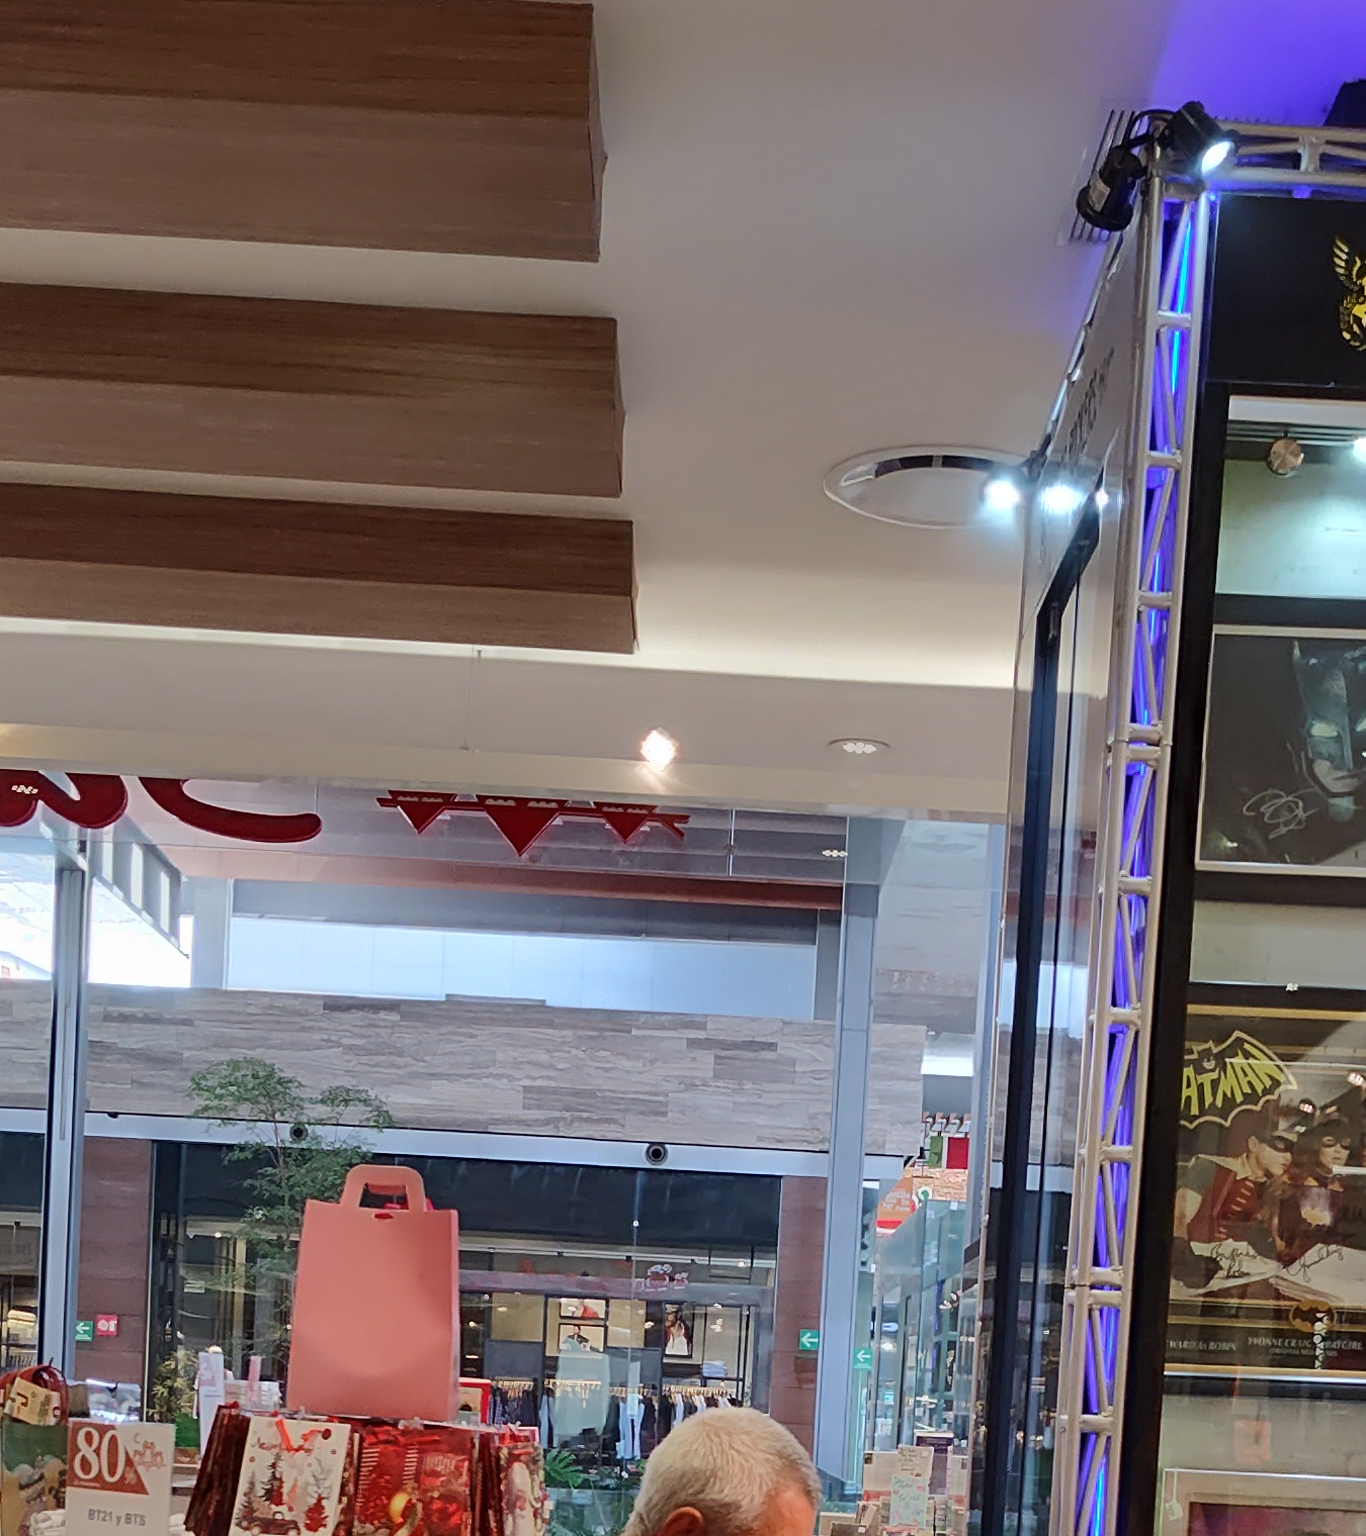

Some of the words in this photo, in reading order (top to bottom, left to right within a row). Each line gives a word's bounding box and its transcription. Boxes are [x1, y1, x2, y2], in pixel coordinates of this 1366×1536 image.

[1180, 1041, 1285, 1117] ATMAN
[87, 1508, 113, 1523] BT21
[124, 1512, 147, 1527] BTS
